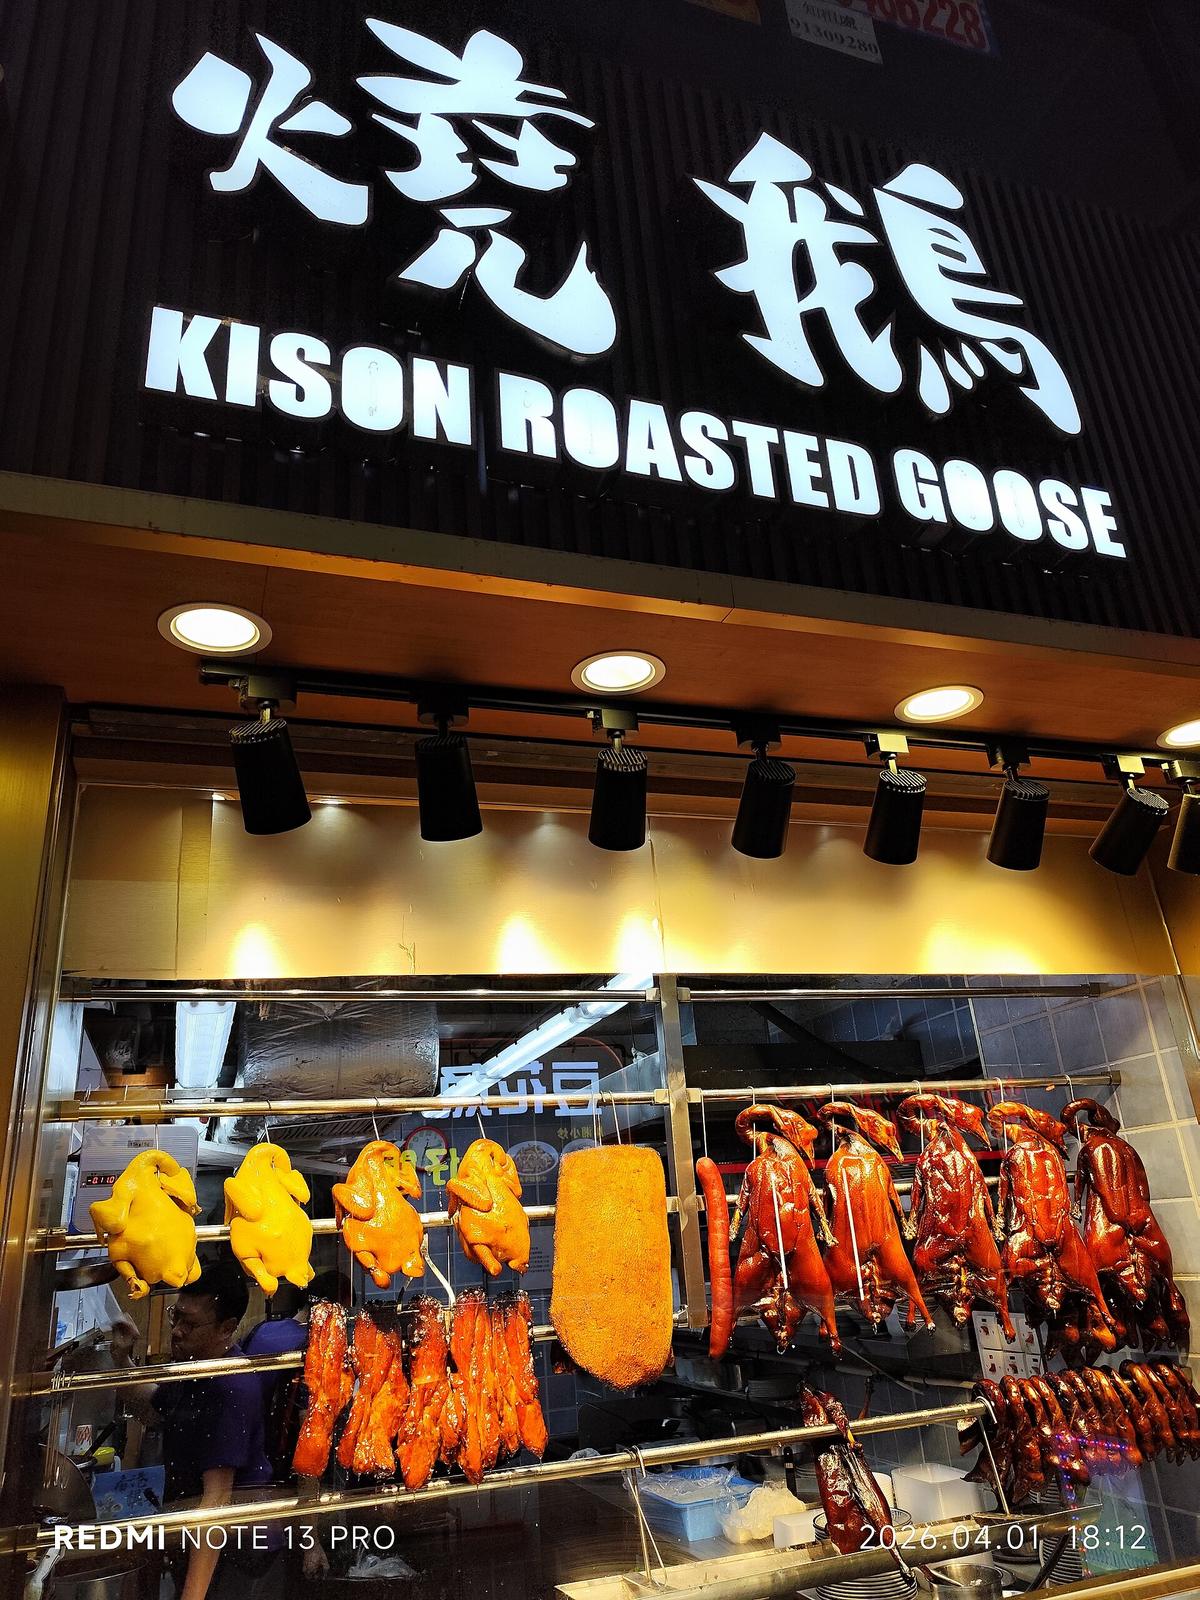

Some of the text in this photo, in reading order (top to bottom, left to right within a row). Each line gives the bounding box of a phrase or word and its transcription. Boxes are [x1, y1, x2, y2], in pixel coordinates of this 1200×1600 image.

[145, 307, 1126, 558] KISON ROASTED GOOSE
